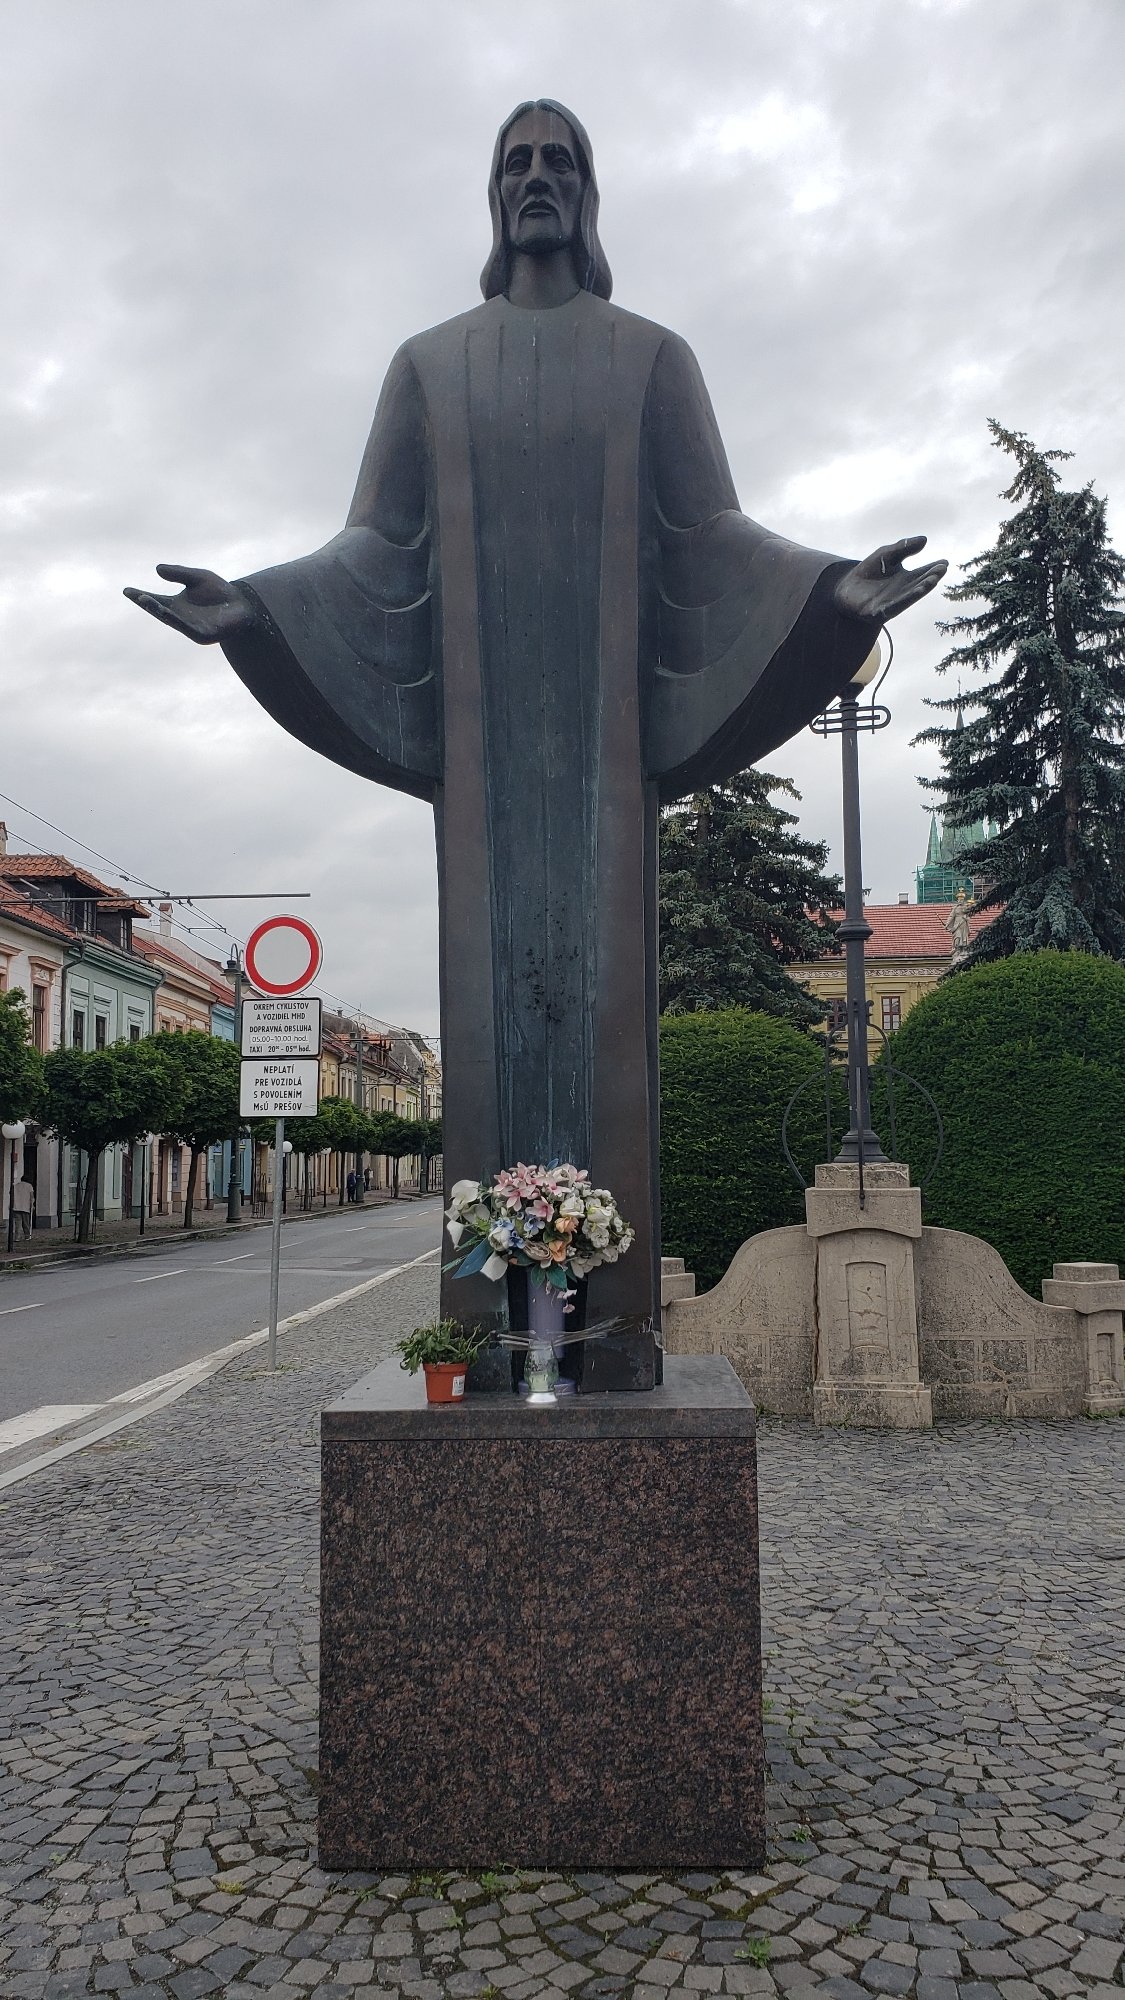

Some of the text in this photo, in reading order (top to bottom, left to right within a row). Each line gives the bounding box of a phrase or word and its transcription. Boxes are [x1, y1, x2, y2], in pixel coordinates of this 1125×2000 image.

[254, 1002, 310, 1011] OKREM CYKLISTOV
[256, 1013, 261, 1021] A
[291, 1012, 306, 1020] MHD
[249, 1023, 313, 1033] DOPRAVNÁ OBSLUHA
[263, 1064, 295, 1074] NEPLATÍ
[255, 1076, 302, 1086] PRE VOZIDLÁ
[253, 1089, 302, 1099] S POVOLENÍM
[253, 1101, 303, 1111] MsÚ PREŠOV
